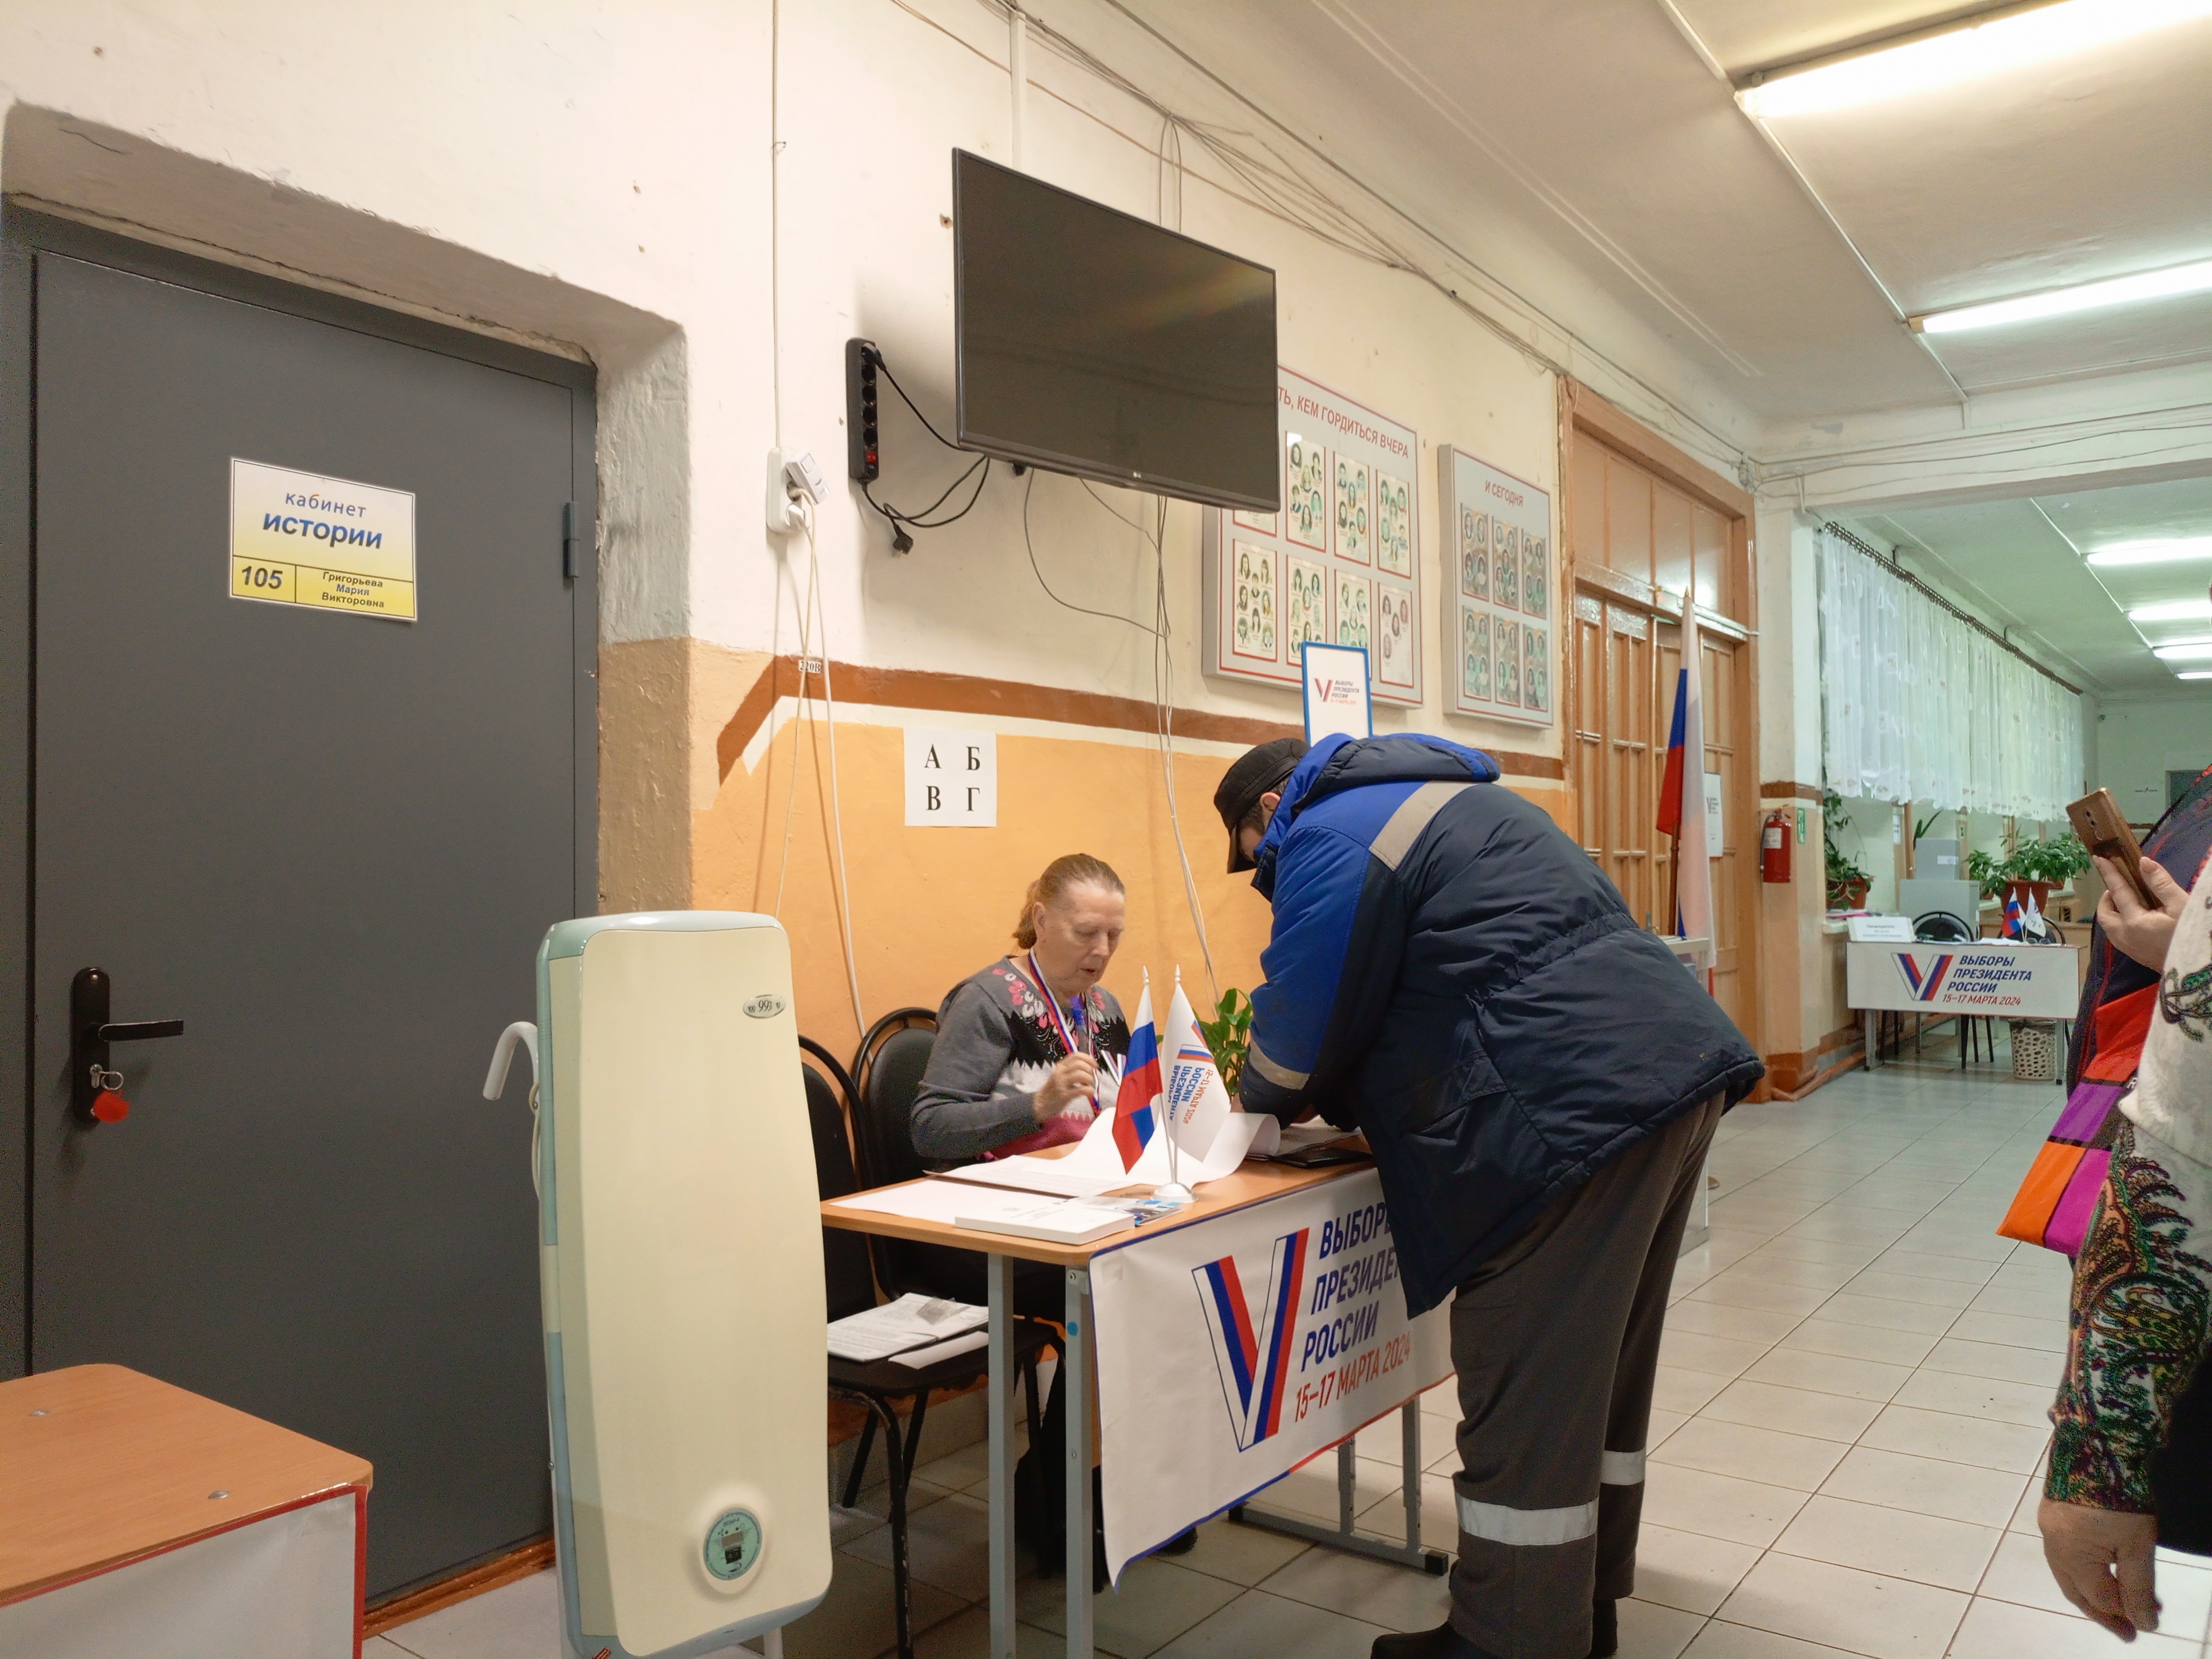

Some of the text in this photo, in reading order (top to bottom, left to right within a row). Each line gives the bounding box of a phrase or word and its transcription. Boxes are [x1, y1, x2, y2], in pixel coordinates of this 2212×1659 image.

[1278, 386, 1408, 458] ТЬ, КЕМ ГОРДИТЬСЯ ВЧЕРА
[285, 493, 366, 517] кабинет
[1485, 480, 1524, 507] И СЕГОДНЯ
[263, 513, 383, 549] истории
[241, 565, 283, 590] 105
[323, 572, 383, 588] Григорьева
[336, 584, 370, 596] Мария
[322, 592, 385, 608] Викторовна
[925, 744, 980, 770] А Б
[926, 785, 980, 812] В Г
[1959, 955, 2015, 966] ВЫБОРЫ
[1947, 982, 1998, 993] РОССИИ
[1953, 969, 2032, 981] ПРЕЗИДЕНТА
[1968, 996, 1997, 1004] МАРТА
[1999, 997, 2021, 1006] 2024
[1310, 1246, 1399, 1315] ПРЕЗИДЕ
[1301, 1299, 1380, 1373] РОССИИ
[1336, 1346, 1380, 1400] МАРТА
[1382, 1330, 1411, 1374] 2024
